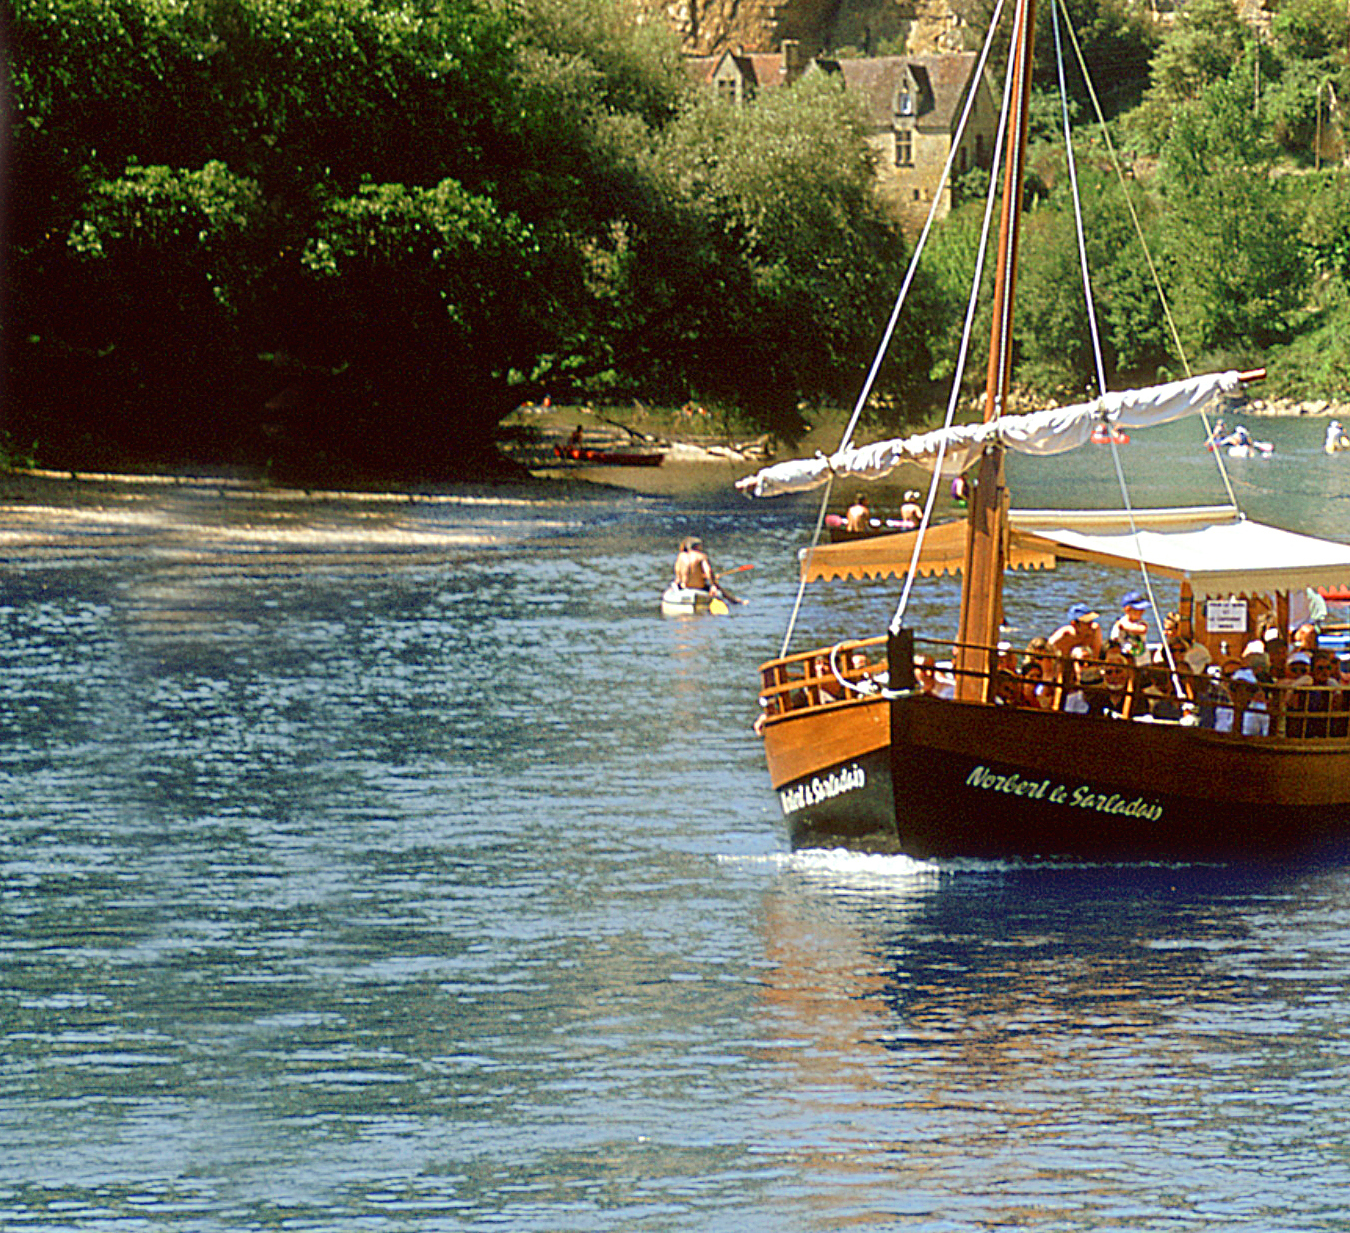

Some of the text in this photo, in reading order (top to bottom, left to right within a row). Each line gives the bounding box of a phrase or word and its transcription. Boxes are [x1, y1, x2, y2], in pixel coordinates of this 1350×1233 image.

[966, 766, 1163, 821] Norbert le Sarladais
